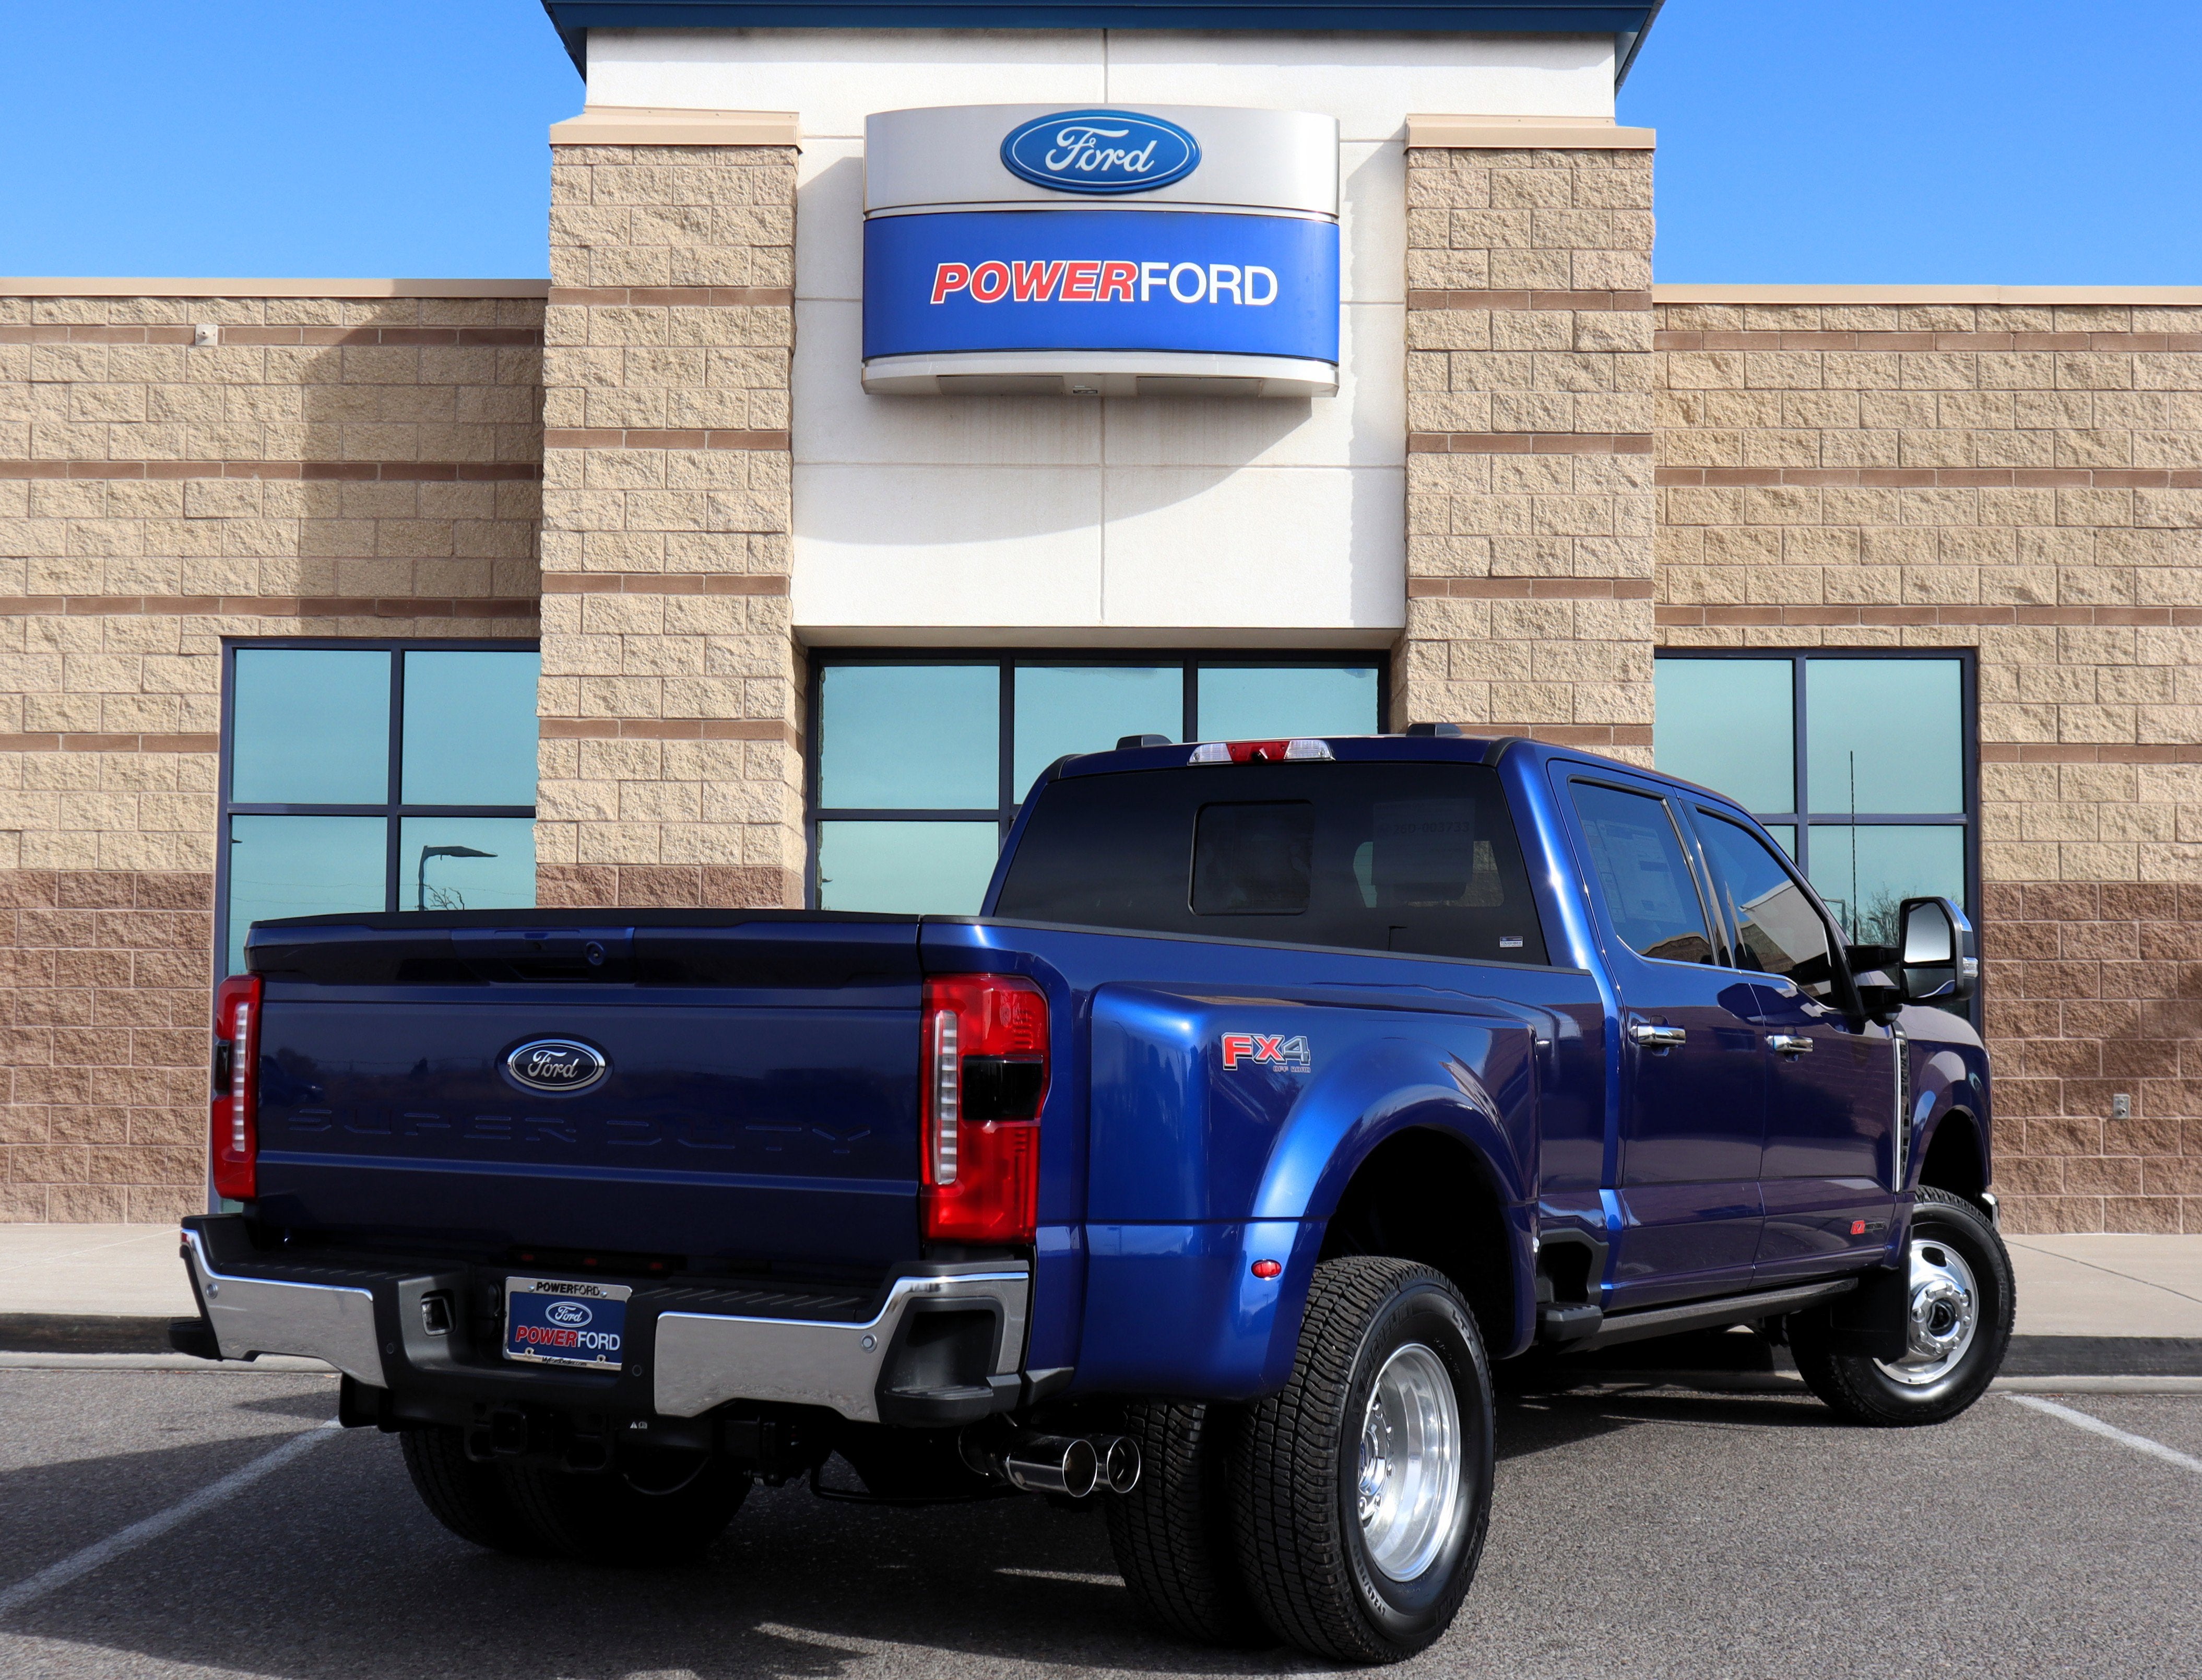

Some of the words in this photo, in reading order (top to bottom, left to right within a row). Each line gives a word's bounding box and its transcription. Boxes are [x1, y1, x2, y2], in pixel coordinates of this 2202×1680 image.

[1045, 126, 1157, 172] Ford
[930, 260, 1278, 306] POWERFORD
[527, 1049, 578, 1080] Ford
[1221, 1032, 1311, 1071] FX4
[288, 1109, 576, 1143] SUPER
[605, 1119, 871, 1154] DUTY
[536, 1282, 600, 1296] POWERFORD
[554, 1306, 582, 1322] Ford
[1452, 1309, 1473, 1346] LTX
[515, 1325, 621, 1351] POWERFORD
